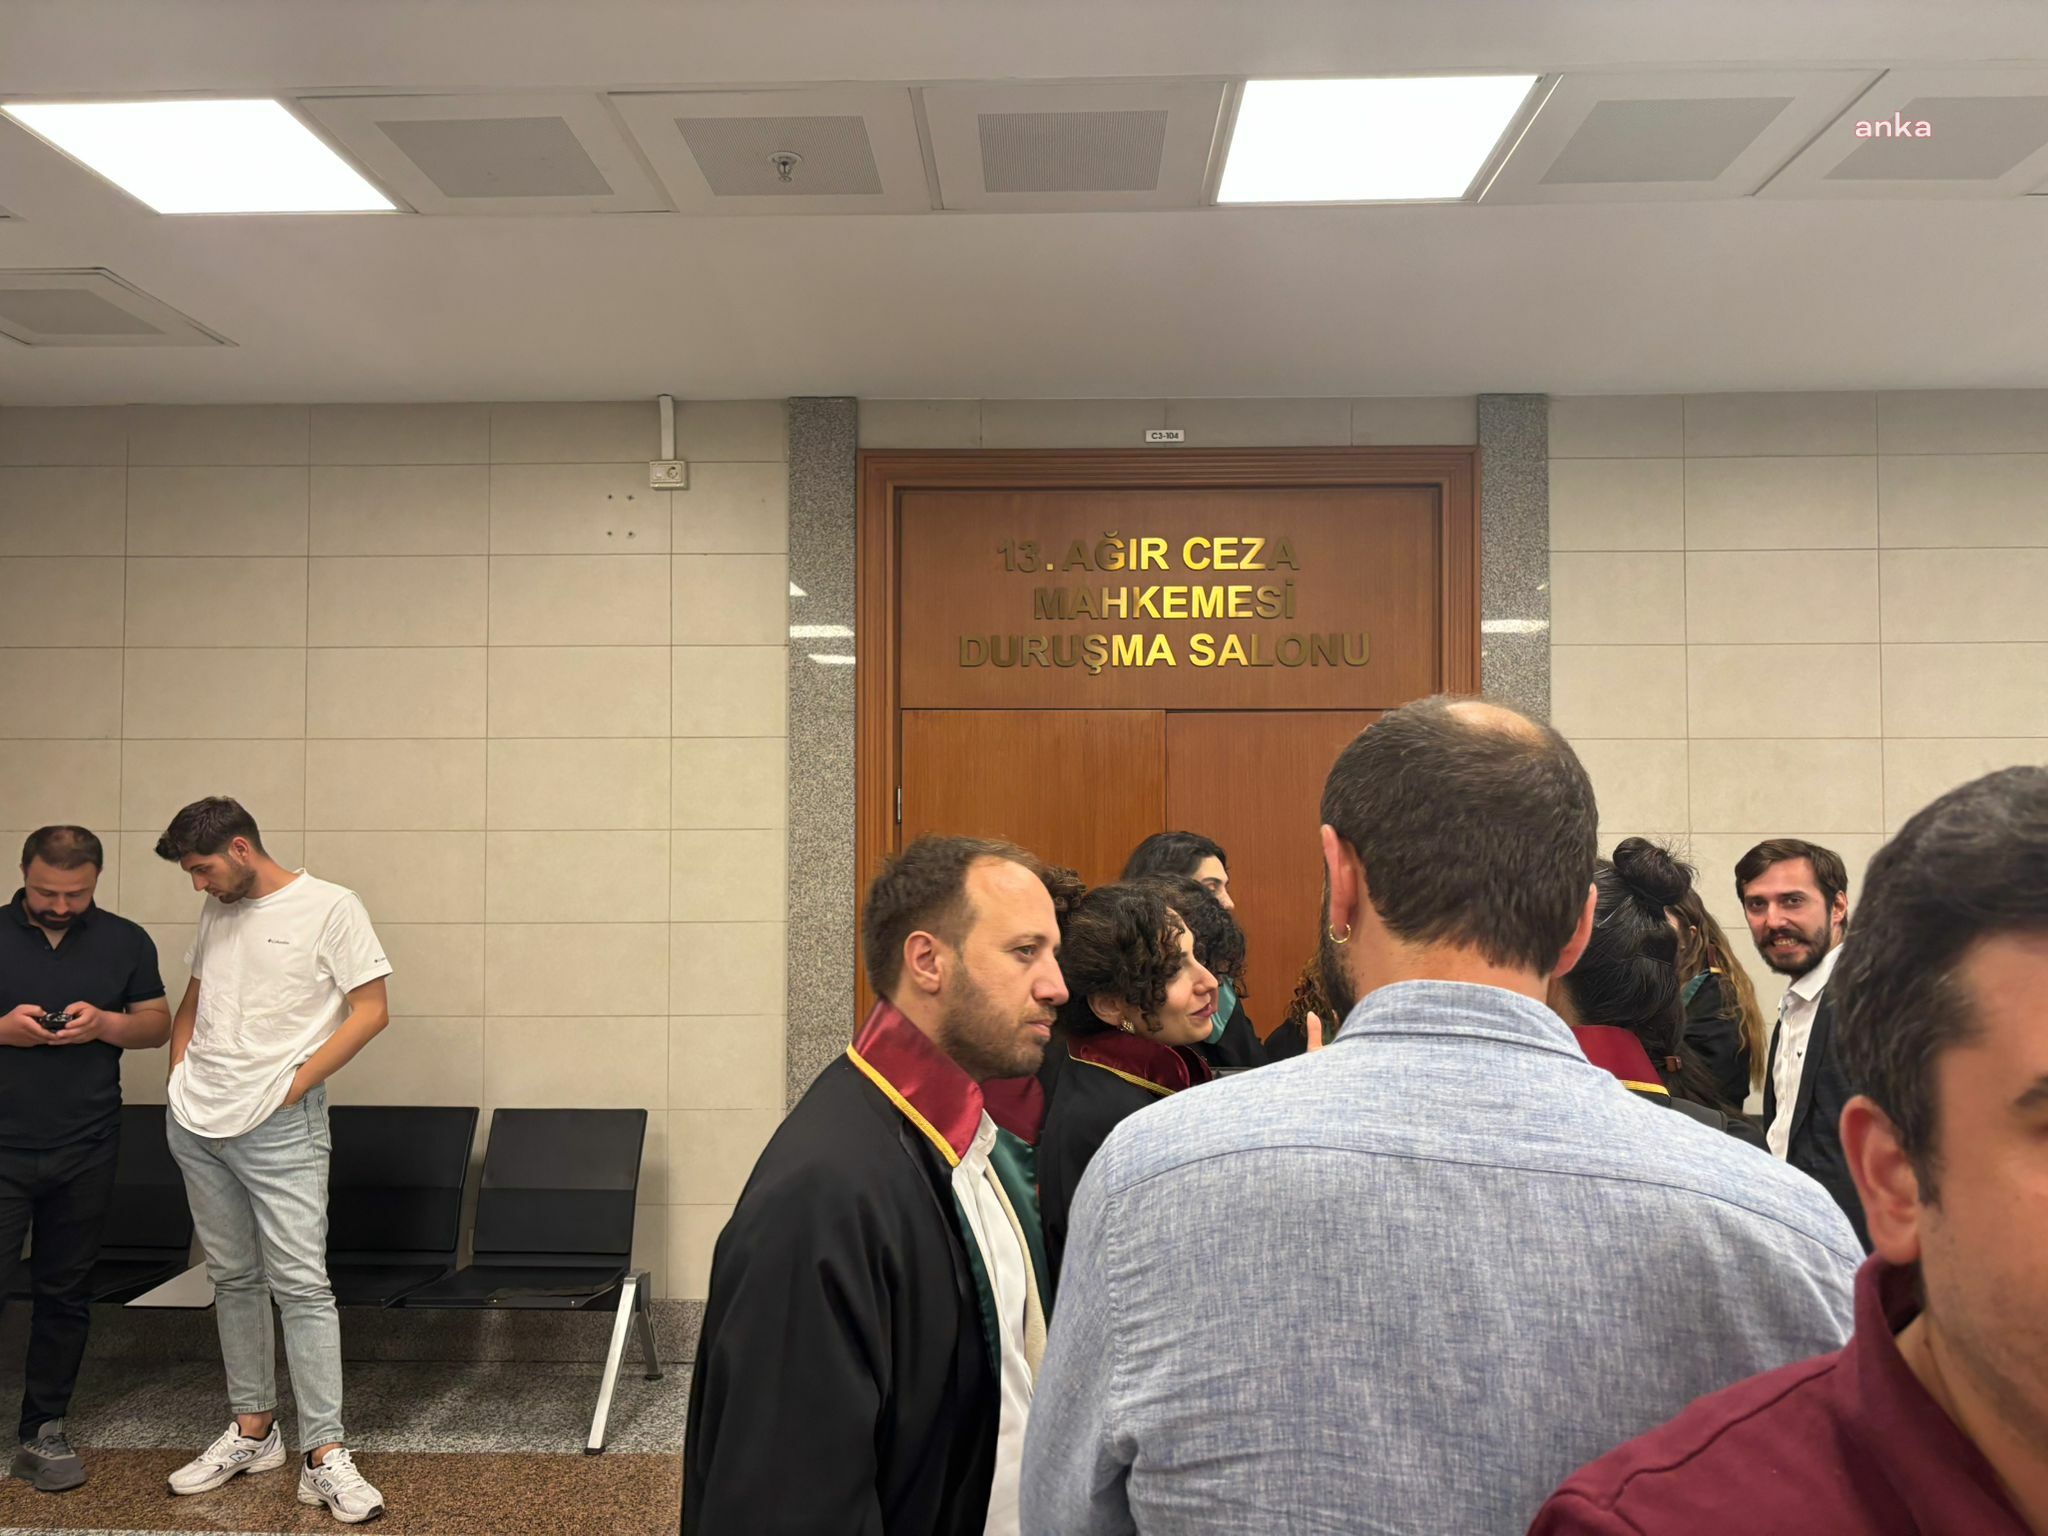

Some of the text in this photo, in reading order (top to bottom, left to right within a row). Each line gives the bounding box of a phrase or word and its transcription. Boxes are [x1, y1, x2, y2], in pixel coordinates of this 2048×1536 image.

[998, 530, 1300, 572] 13. AĞIR CEZA
[1033, 579, 1296, 620] MAHKEMESİ
[959, 632, 1371, 674] DURUŞMA SALONU
